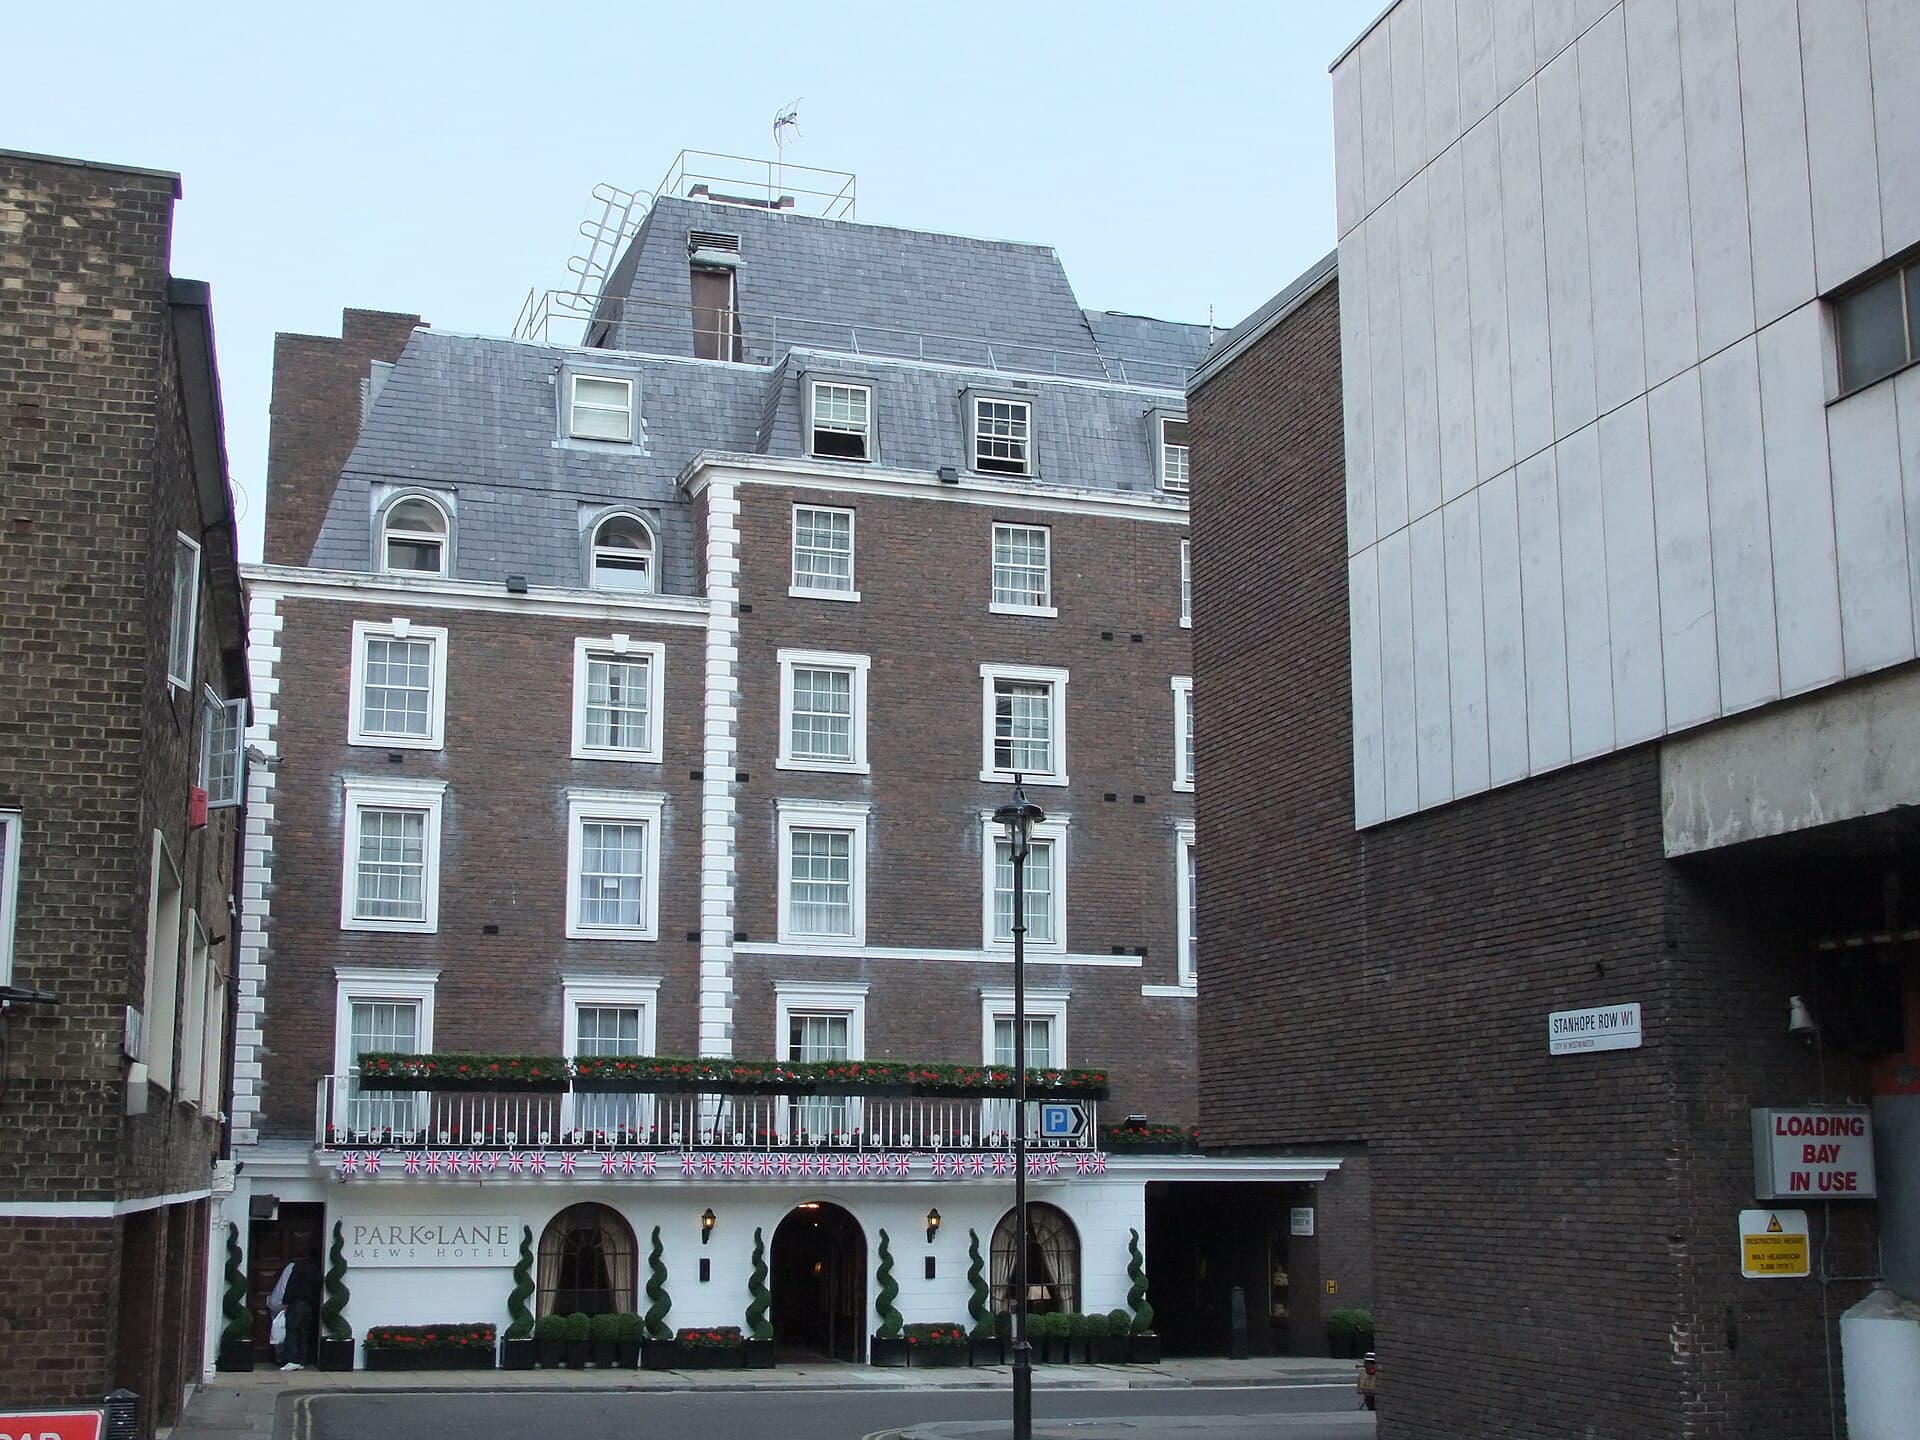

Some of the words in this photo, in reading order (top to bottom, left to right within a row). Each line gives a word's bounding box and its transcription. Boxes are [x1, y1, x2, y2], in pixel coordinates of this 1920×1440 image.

[1554, 1015, 1595, 1033] STANHOPE
[1598, 1012, 1617, 1029] ROW
[1621, 1011, 1633, 1026] W1
[1051, 1111, 1065, 1130] P
[1775, 1116, 1864, 1136] LOADING
[1802, 1144, 1840, 1164] BAY
[1789, 1172, 1810, 1191] IN
[1817, 1172, 1857, 1191] USE
[353, 1225, 427, 1245] PARK
[437, 1225, 509, 1245] LANE
[353, 1248, 416, 1258] MEWS
[436, 1248, 509, 1258] HOTEL
